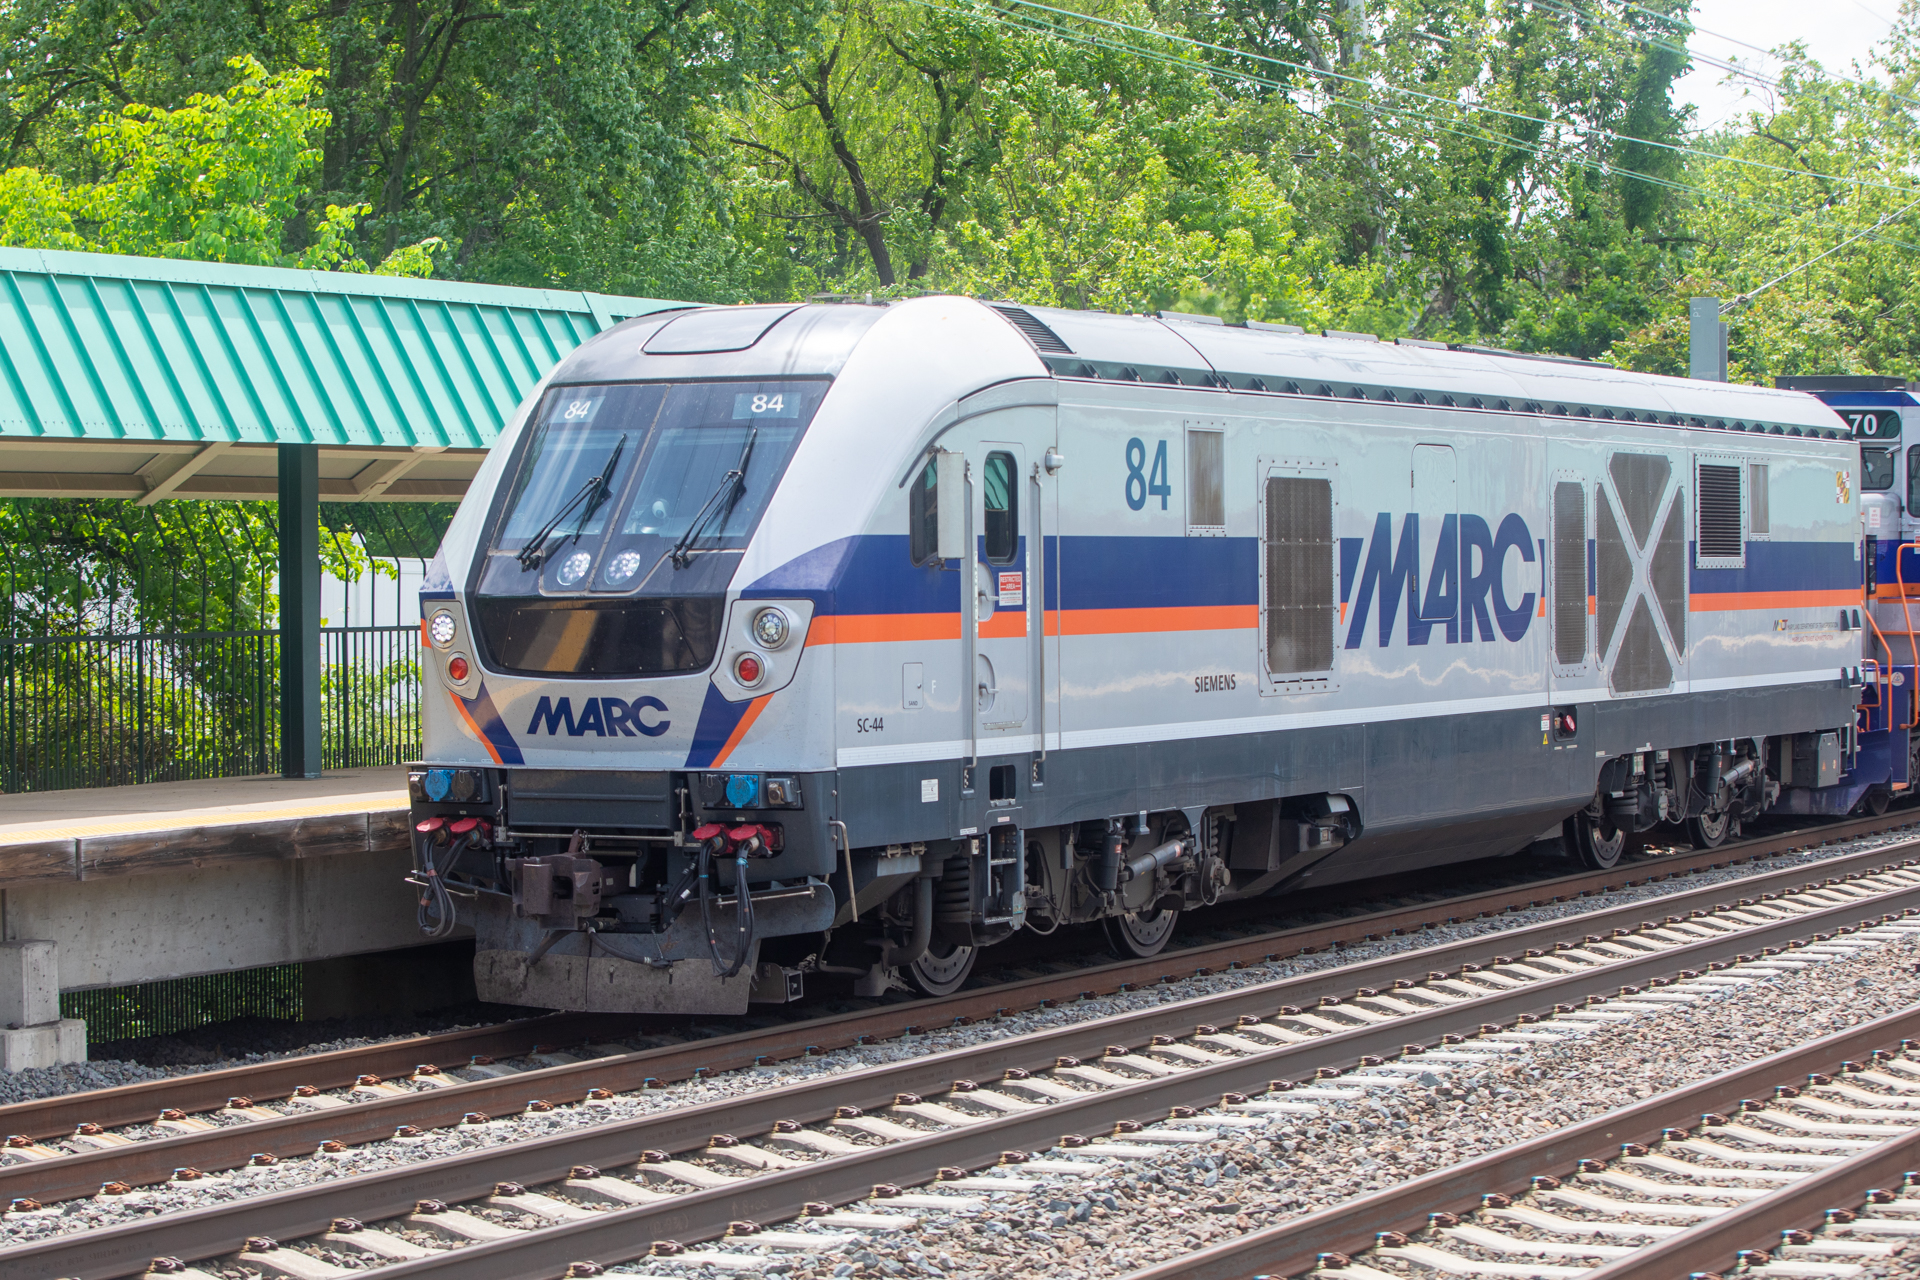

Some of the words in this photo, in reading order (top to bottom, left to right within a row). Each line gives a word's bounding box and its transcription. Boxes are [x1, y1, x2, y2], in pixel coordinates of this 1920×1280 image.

[564, 400, 592, 419] 84
[751, 393, 784, 413] 84
[1849, 414, 1878, 436] 70
[1125, 437, 1171, 511] 84
[1000, 575, 1021, 583] RESTRICTED
[1344, 512, 1536, 650] MARC
[931, 679, 937, 694] F
[1194, 673, 1236, 693] SIEMENS
[526, 695, 671, 737] MARC
[856, 716, 884, 733] SC-44
